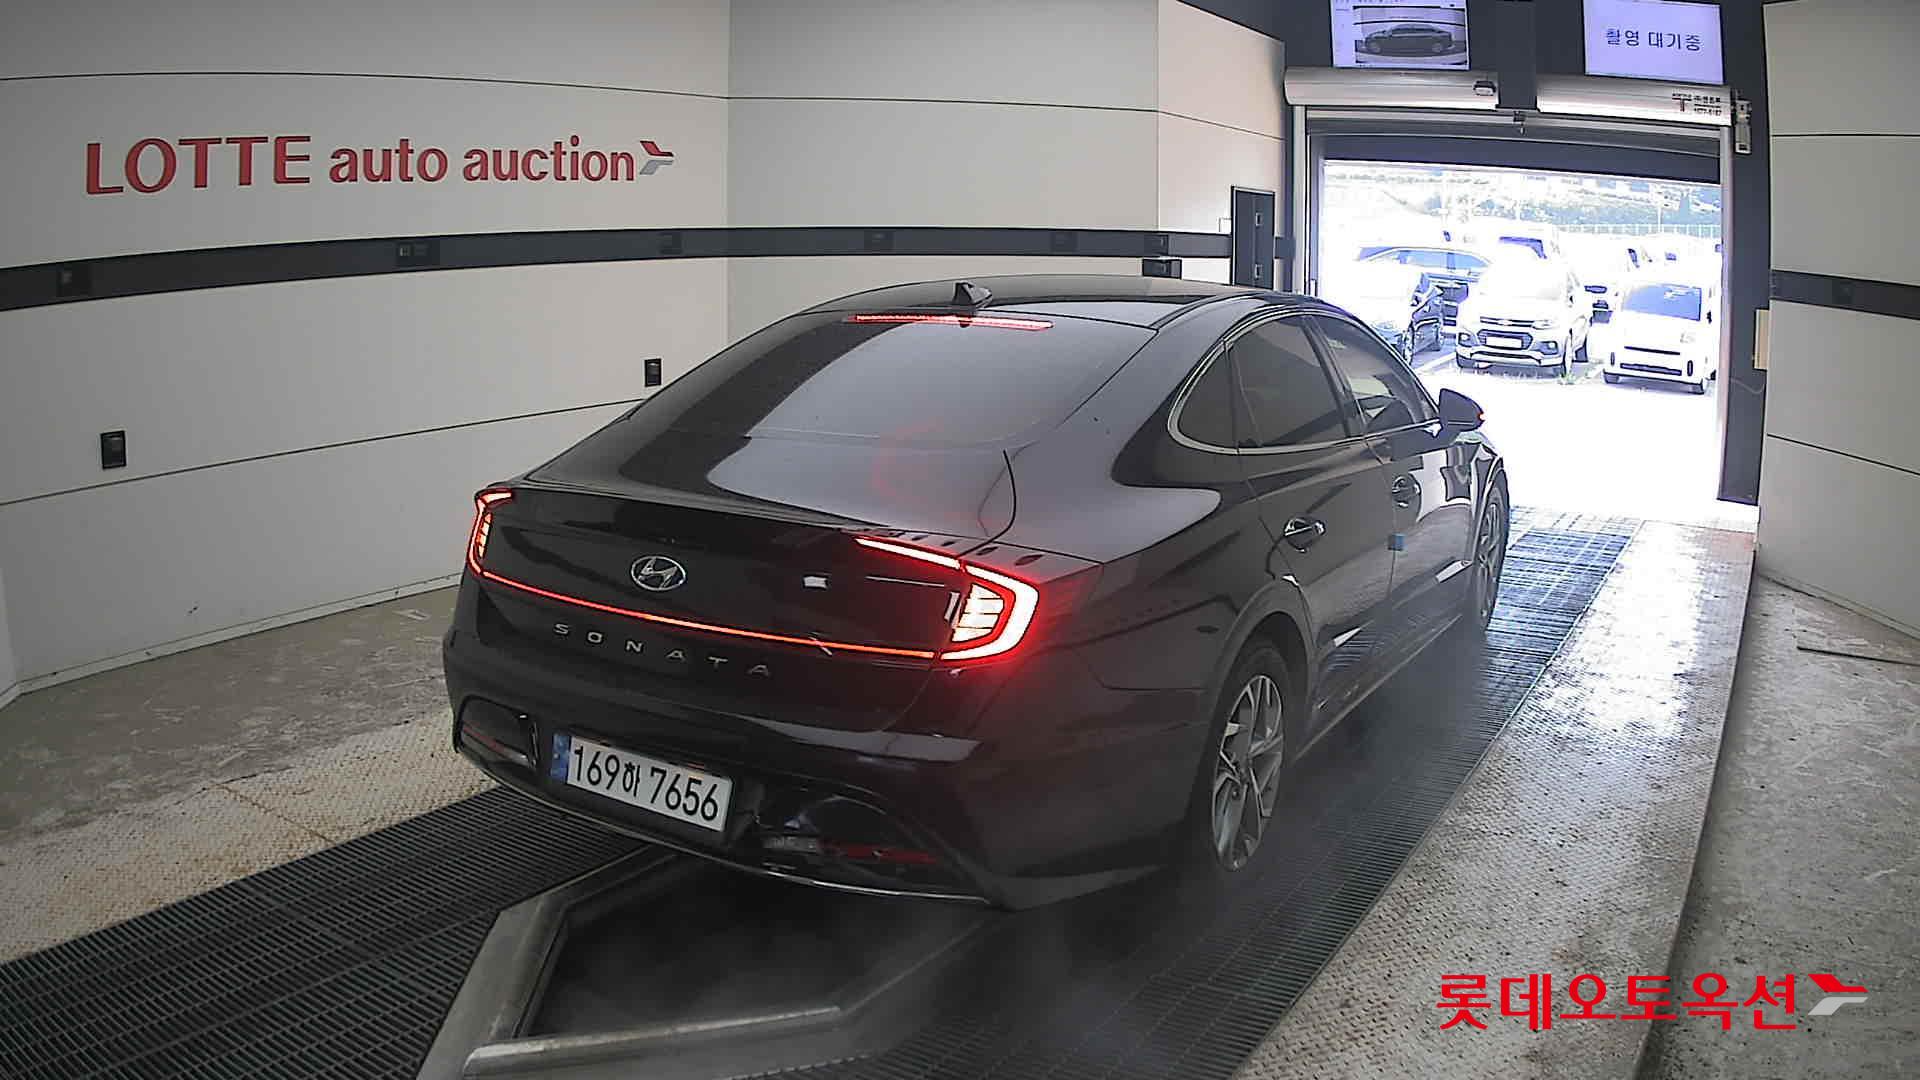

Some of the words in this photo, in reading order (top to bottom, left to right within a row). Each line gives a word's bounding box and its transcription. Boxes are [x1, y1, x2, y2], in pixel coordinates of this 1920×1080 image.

[1648, 31, 1701, 52] 대기중
[88, 137, 312, 194] LOTTE
[330, 138, 449, 183] auto
[464, 136, 635, 182] auction
[553, 623, 769, 676] SONATA
[650, 766, 719, 821] 7656
